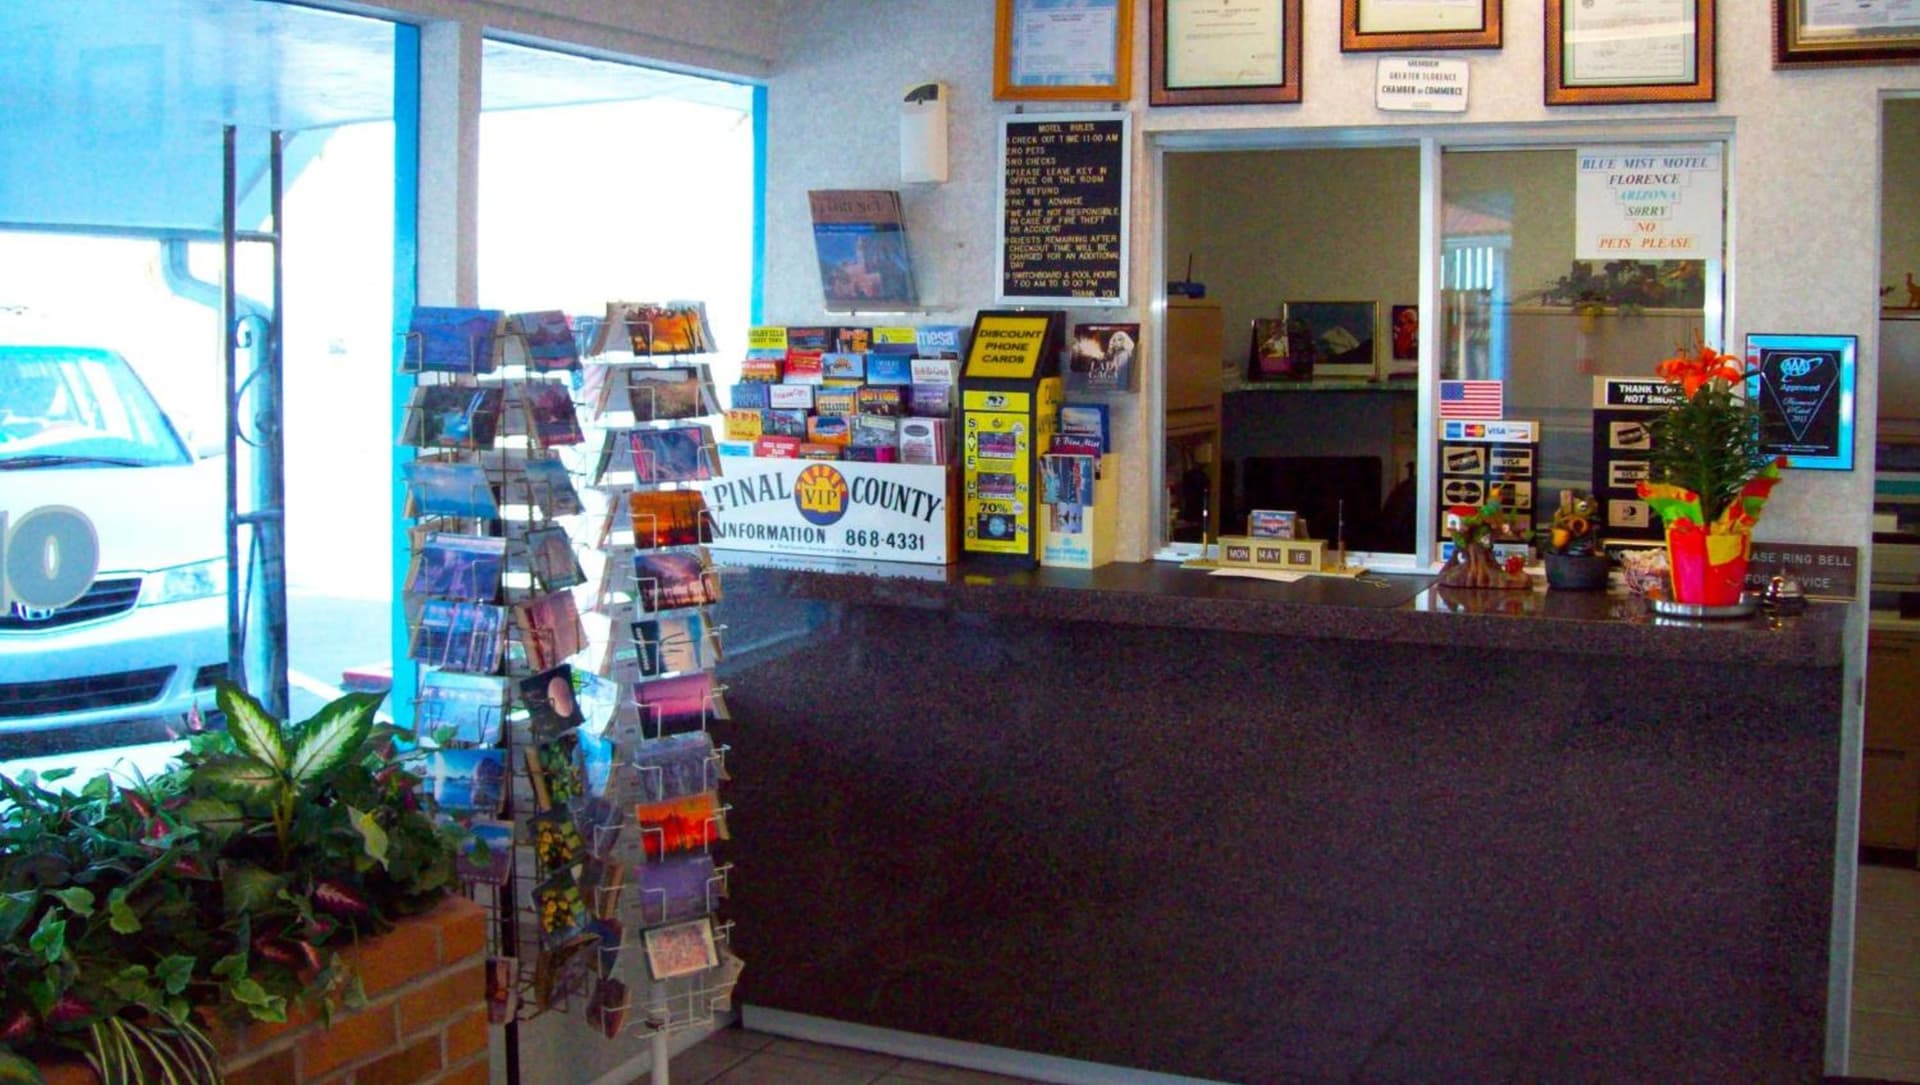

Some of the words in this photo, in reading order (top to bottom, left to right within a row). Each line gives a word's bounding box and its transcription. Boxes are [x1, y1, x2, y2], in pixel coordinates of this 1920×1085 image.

[1390, 72, 1420, 80] GREATER
[1422, 72, 1456, 82] FLORENCE
[1382, 85, 1416, 94] CHAMBER
[1424, 86, 1462, 96] COMMERCE
[1038, 124, 1062, 132] MOTEL
[1070, 124, 1094, 132] RULES
[1012, 136, 1037, 144] CHECK
[1105, 134, 1118, 142] AM
[1026, 146, 1044, 154] PETS
[1026, 158, 1056, 166] CHECKS
[1582, 158, 1616, 169] BLUE
[1624, 158, 1658, 169] MIST
[1663, 158, 1708, 168] MOTEL
[1011, 168, 1040, 176] PLEASE
[1046, 168, 1071, 176] LEAVE
[1076, 166, 1093, 175] KEY
[1010, 176, 1037, 185] OFFICE
[1059, 176, 1076, 184] THE
[1609, 174, 1680, 185] FLORENCE
[1026, 187, 1059, 196] REFUND
[1620, 190, 1678, 200] ARIZONA
[1012, 198, 1026, 206] PAY
[1048, 197, 1083, 206] ADVANCE
[1046, 208, 1061, 216] NOT
[1066, 208, 1119, 216] RESPONSIBLE
[1626, 206, 1667, 217] SORRY
[1020, 217, 1040, 225] CASE
[1080, 216, 1105, 224] THEFT
[1636, 222, 1656, 232] NO
[1045, 236, 1087, 244] REMAINING
[1090, 234, 1117, 242] AFTER
[1600, 238, 1632, 248] PETS
[1640, 238, 1692, 248] PLEASE
[1009, 244, 1048, 252] CHECKOUT
[1054, 244, 1072, 252] TIME
[1009, 253, 1042, 261] CHARGED
[1066, 252, 1076, 260] AN
[1079, 252, 1120, 260] ADDITIONAL
[1010, 262, 1024, 270] DAY
[1012, 271, 1062, 279] SWITCHBOARD
[1093, 270, 1117, 278] HOURS
[1072, 290, 1094, 298] THANK
[1102, 289, 1116, 297] YOU
[919, 331, 954, 346] mesa
[979, 330, 1042, 338] DISCOUNT
[985, 342, 1029, 352] PHONE
[982, 355, 1024, 364] CARDS
[1783, 358, 1807, 375] AAA
[1618, 384, 1652, 394] THANK
[1624, 394, 1646, 403] NOT
[967, 418, 976, 466] SAVE
[714, 471, 791, 511] PINAL
[803, 490, 838, 506] VIP
[851, 476, 942, 524] COUNTY
[979, 502, 1008, 512] 70%
[721, 523, 826, 544] INFORMATION
[846, 529, 925, 551] 868-4331
[1229, 548, 1249, 558] MON
[1258, 550, 1280, 560] MAY
[1782, 553, 1812, 564] RING
[1818, 554, 1852, 566] BELL
